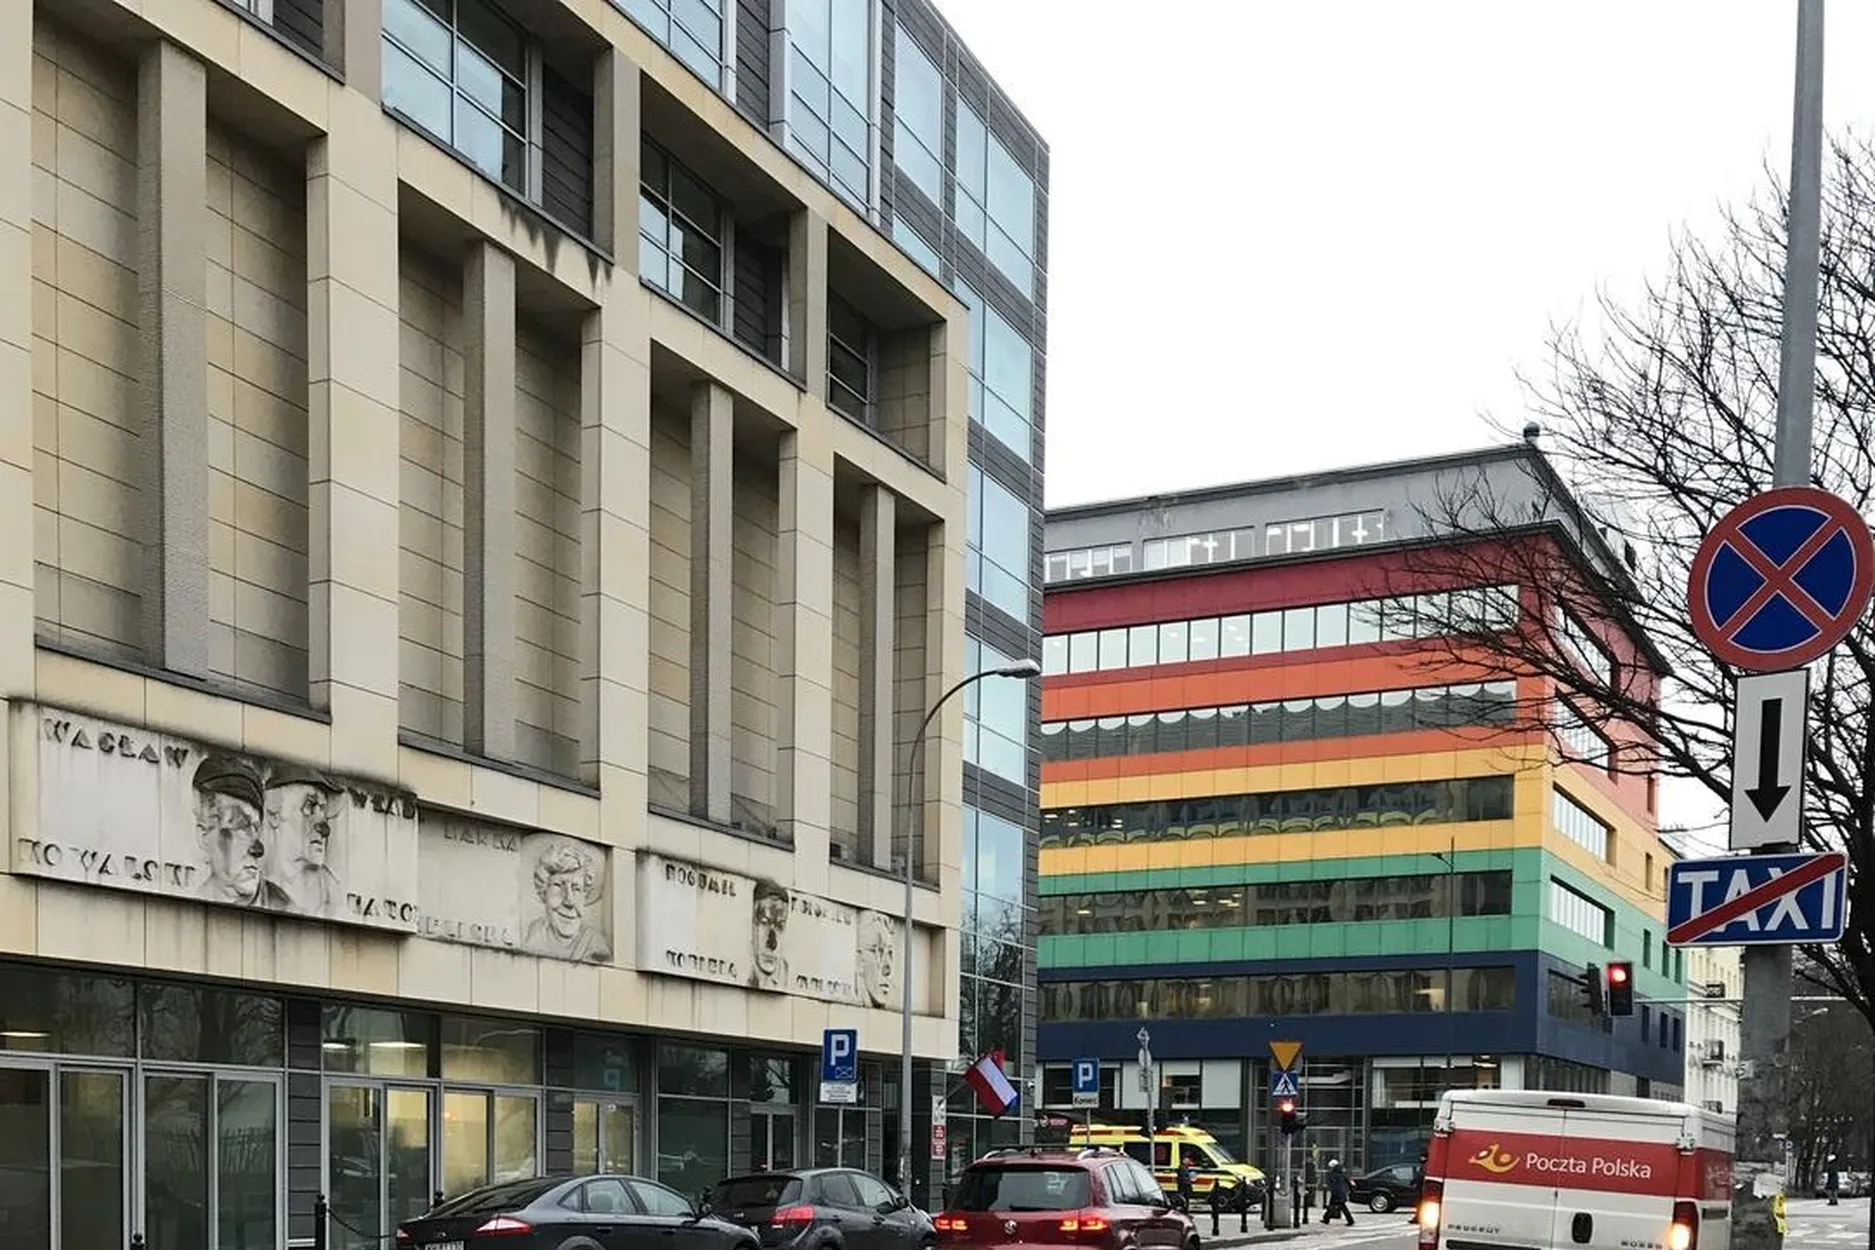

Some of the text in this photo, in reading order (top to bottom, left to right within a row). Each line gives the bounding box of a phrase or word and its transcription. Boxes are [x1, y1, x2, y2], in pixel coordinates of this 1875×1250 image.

[1677, 867, 1838, 932] TAXI
[830, 1034, 850, 1066] P
[1078, 1063, 1093, 1089] P
[1526, 1152, 1652, 1179] Poczta Polska
